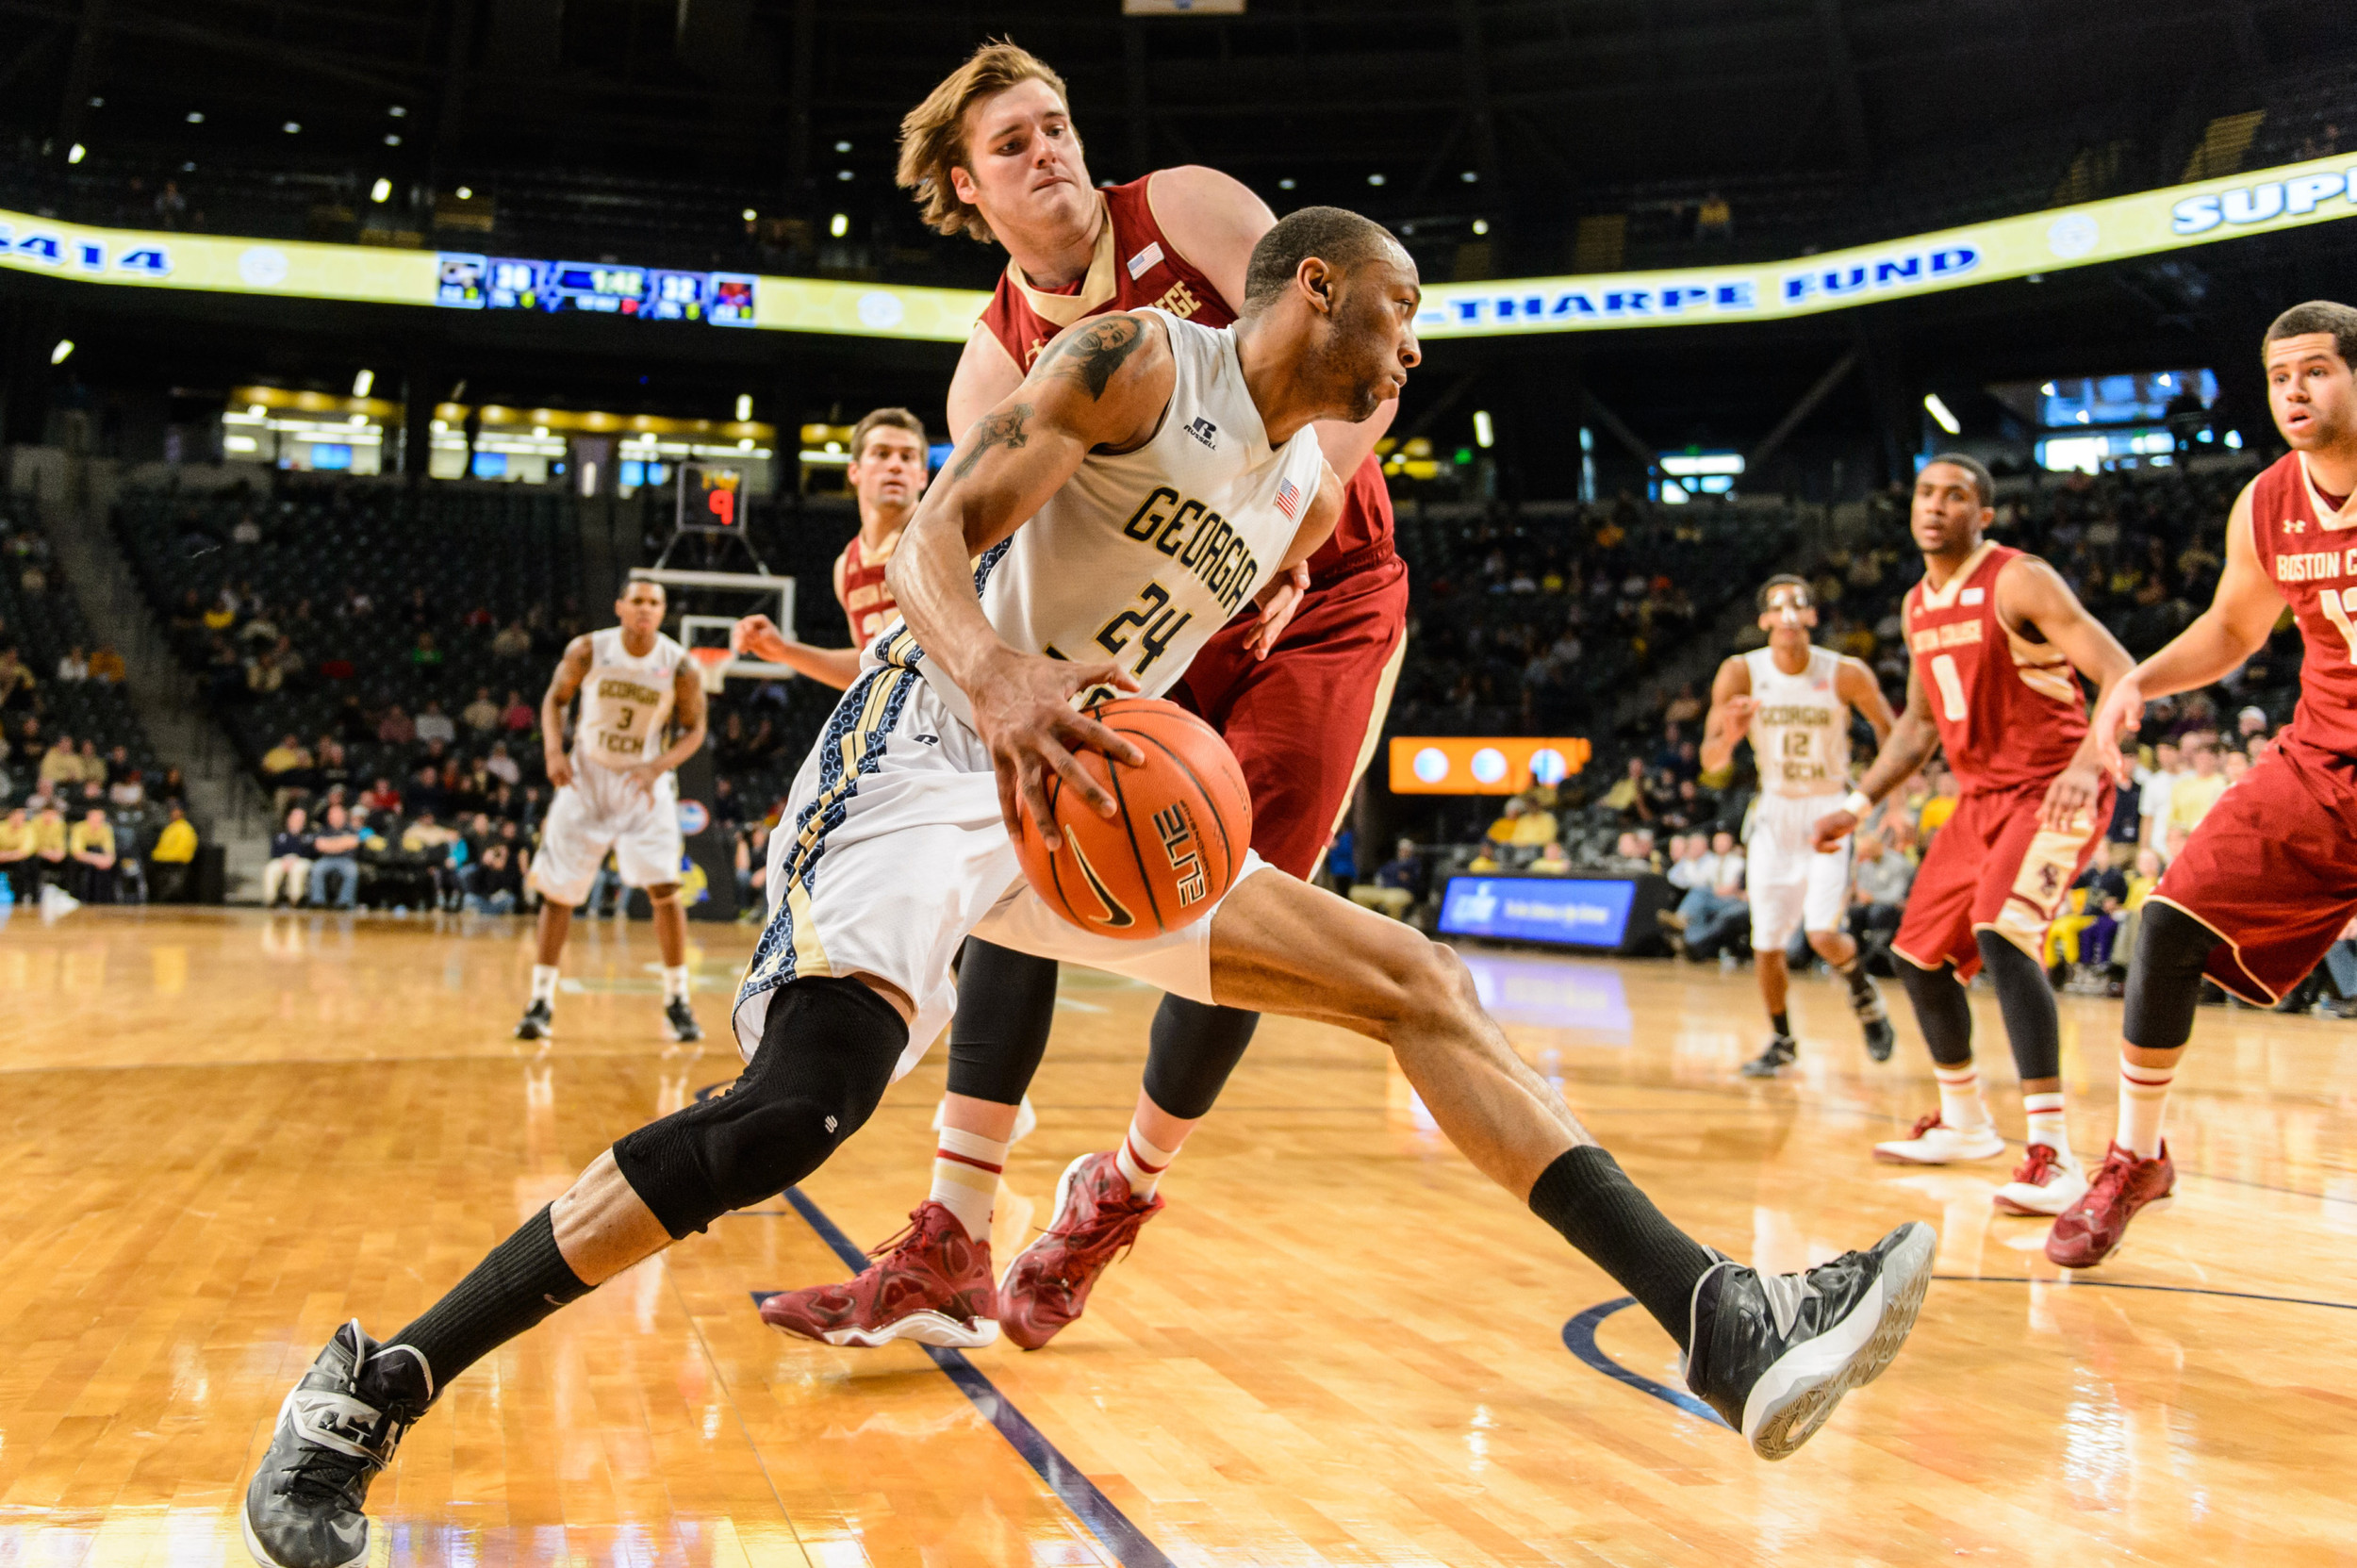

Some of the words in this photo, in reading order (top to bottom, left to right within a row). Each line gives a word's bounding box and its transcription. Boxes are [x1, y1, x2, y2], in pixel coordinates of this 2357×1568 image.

[2172, 167, 2357, 235] SUP
[0, 228, 173, 275] 414
[1781, 247, 1983, 305] FUND
[1182, 424, 1216, 451] RUSSELL
[708, 489, 733, 525] 9
[1123, 484, 1259, 619] GEORGIA
[2276, 551, 2340, 582] BOSTON
[1094, 578, 1196, 681] 24
[598, 679, 661, 706] GEORGIA
[616, 705, 635, 731] 3
[1783, 732, 1809, 757] 12
[1152, 802, 1208, 909] ELITE
